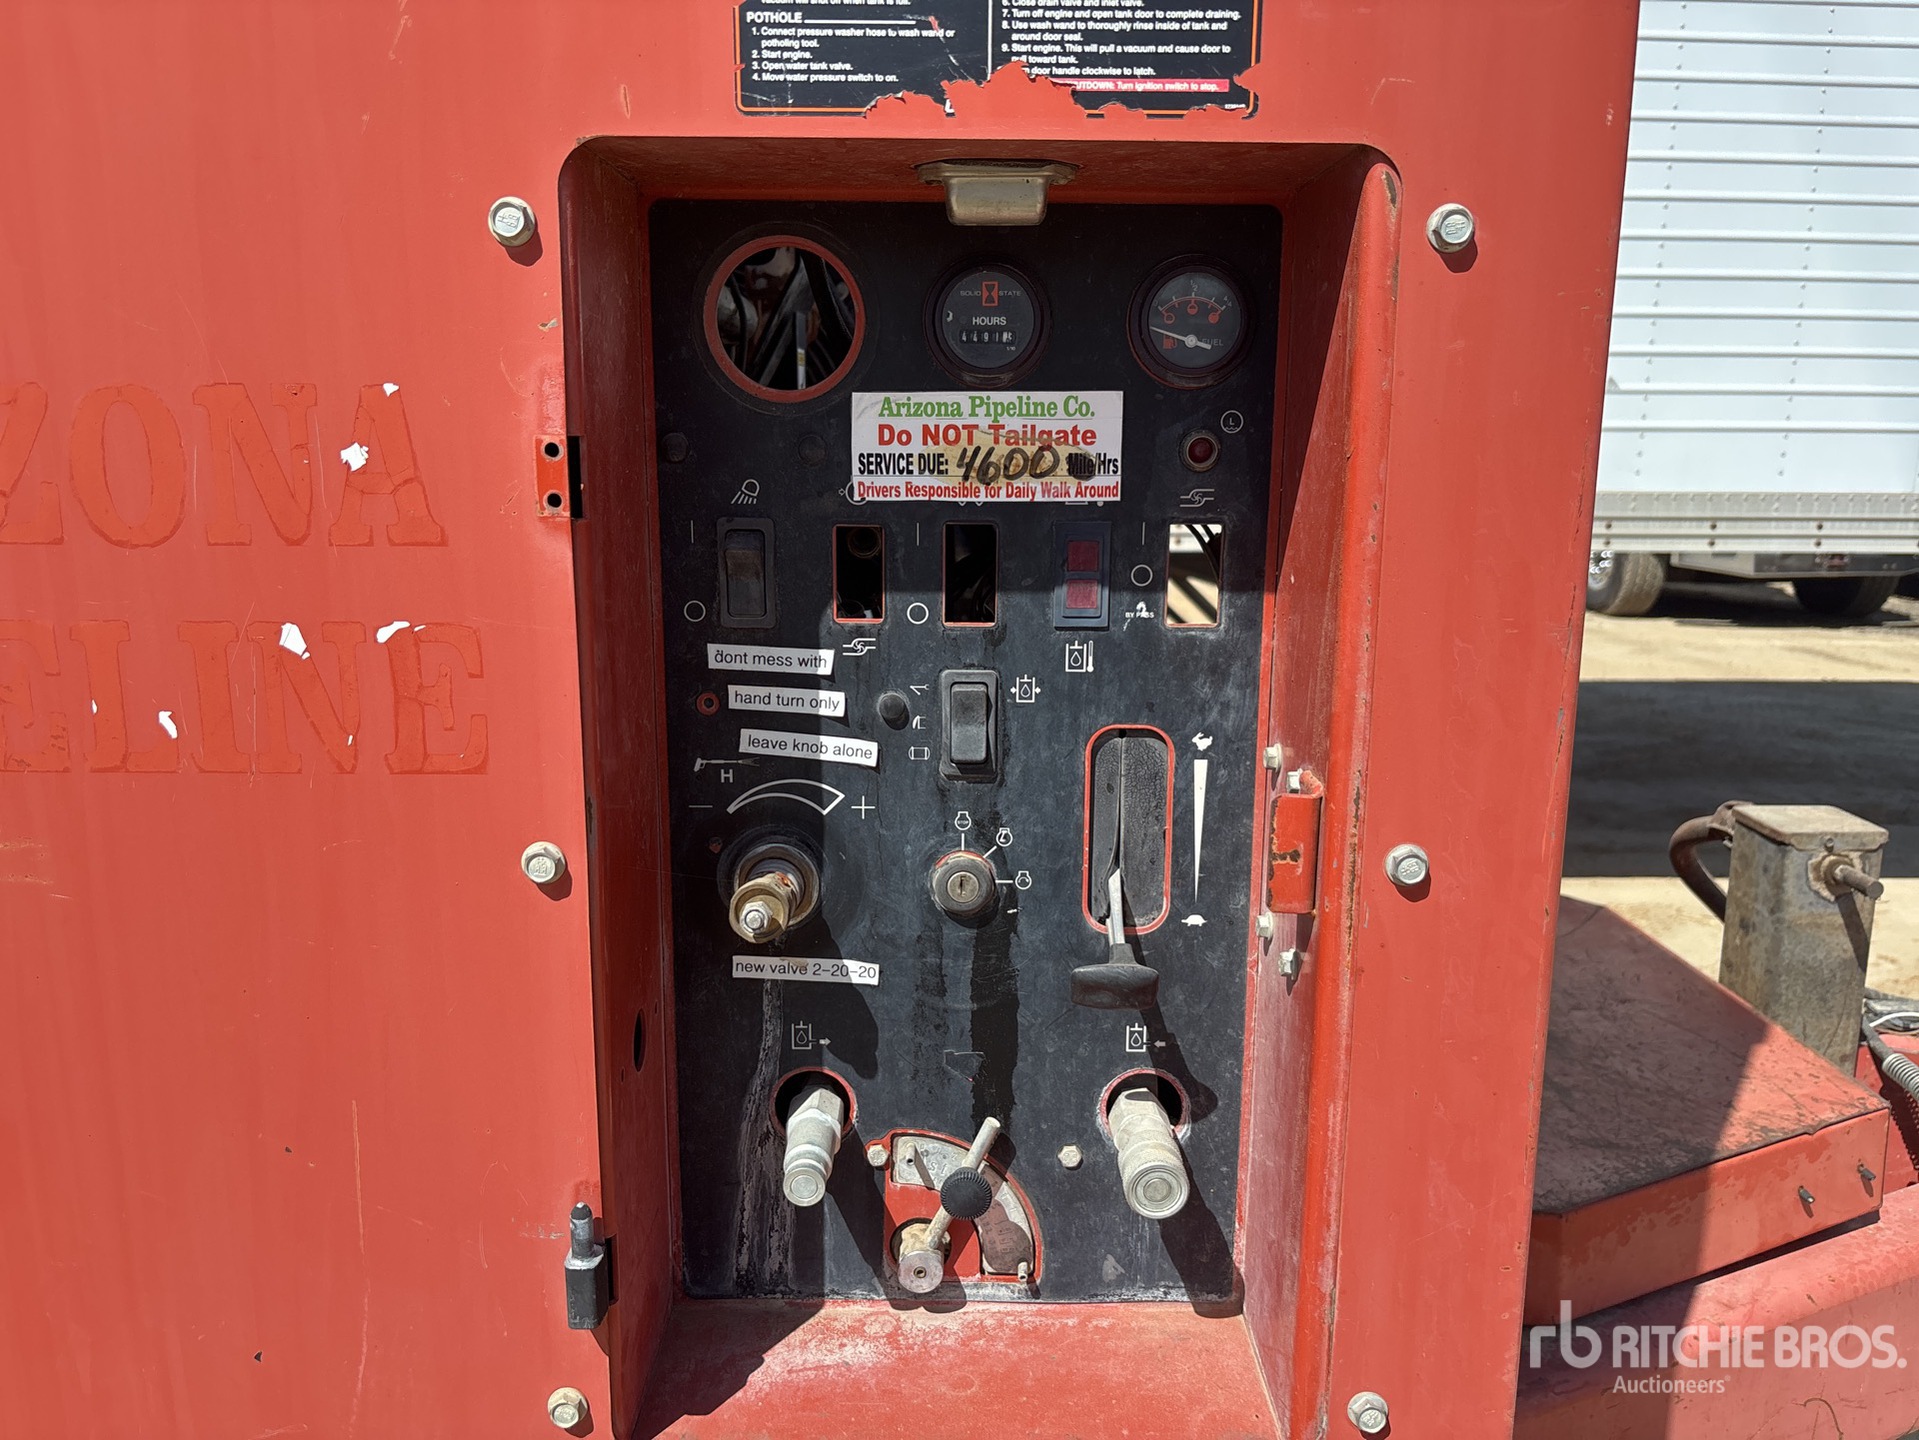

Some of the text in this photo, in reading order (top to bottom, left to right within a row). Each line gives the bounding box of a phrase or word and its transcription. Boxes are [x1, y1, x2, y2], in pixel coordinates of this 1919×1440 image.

[746, 11, 803, 24] POTHOLE
[1001, 8, 1241, 21] 7. Turn off engine and open tank door to complete draining.
[751, 26, 956, 38] 1. Connect pressure washer hose to wash wand or
[1001, 20, 1228, 32] 8. Use wash wand to thoroughly rinse inside of tank and
[1011, 31, 1084, 42] around door seal.
[761, 38, 820, 50] potholing tool.
[1001, 42, 1231, 55] 9. Start engine. This will pull a vacuum and cause door to
[751, 49, 813, 61] 2. Start engine.
[1027, 54, 1057, 64] toward
[1057, 55, 1079, 64] tank.
[751, 60, 854, 72] 3. Open water tank valve.
[1030, 66, 1051, 76] door
[1052, 66, 1081, 75] handle
[1081, 66, 1123, 75] clockwise
[1122, 66, 1133, 76] to
[1133, 66, 1156, 76] latch.
[751, 72, 899, 83] 4. Move water pressure switch to on.
[1116, 81, 1134, 90] Turn
[1134, 81, 1164, 92] ignition
[1164, 82, 1189, 91] switch
[1190, 83, 1199, 91] to
[1200, 83, 1219, 93] stop.
[972, 316, 1007, 326] HOURS
[878, 395, 1095, 423] Arizona Pipeline Co.
[877, 424, 1097, 450] Do NOT Tailgate
[858, 453, 914, 475] SERVICE
[918, 453, 949, 475] DUE:
[956, 445, 1060, 486] 4600
[858, 481, 1119, 502] Drivers Responsible for Daily Walk Around
[714, 650, 827, 668] dont mess with
[734, 691, 840, 711] hand turn only
[748, 734, 873, 759] leave knob alone
[720, 768, 734, 783] H
[735, 961, 877, 978] new valve 2-20-20
